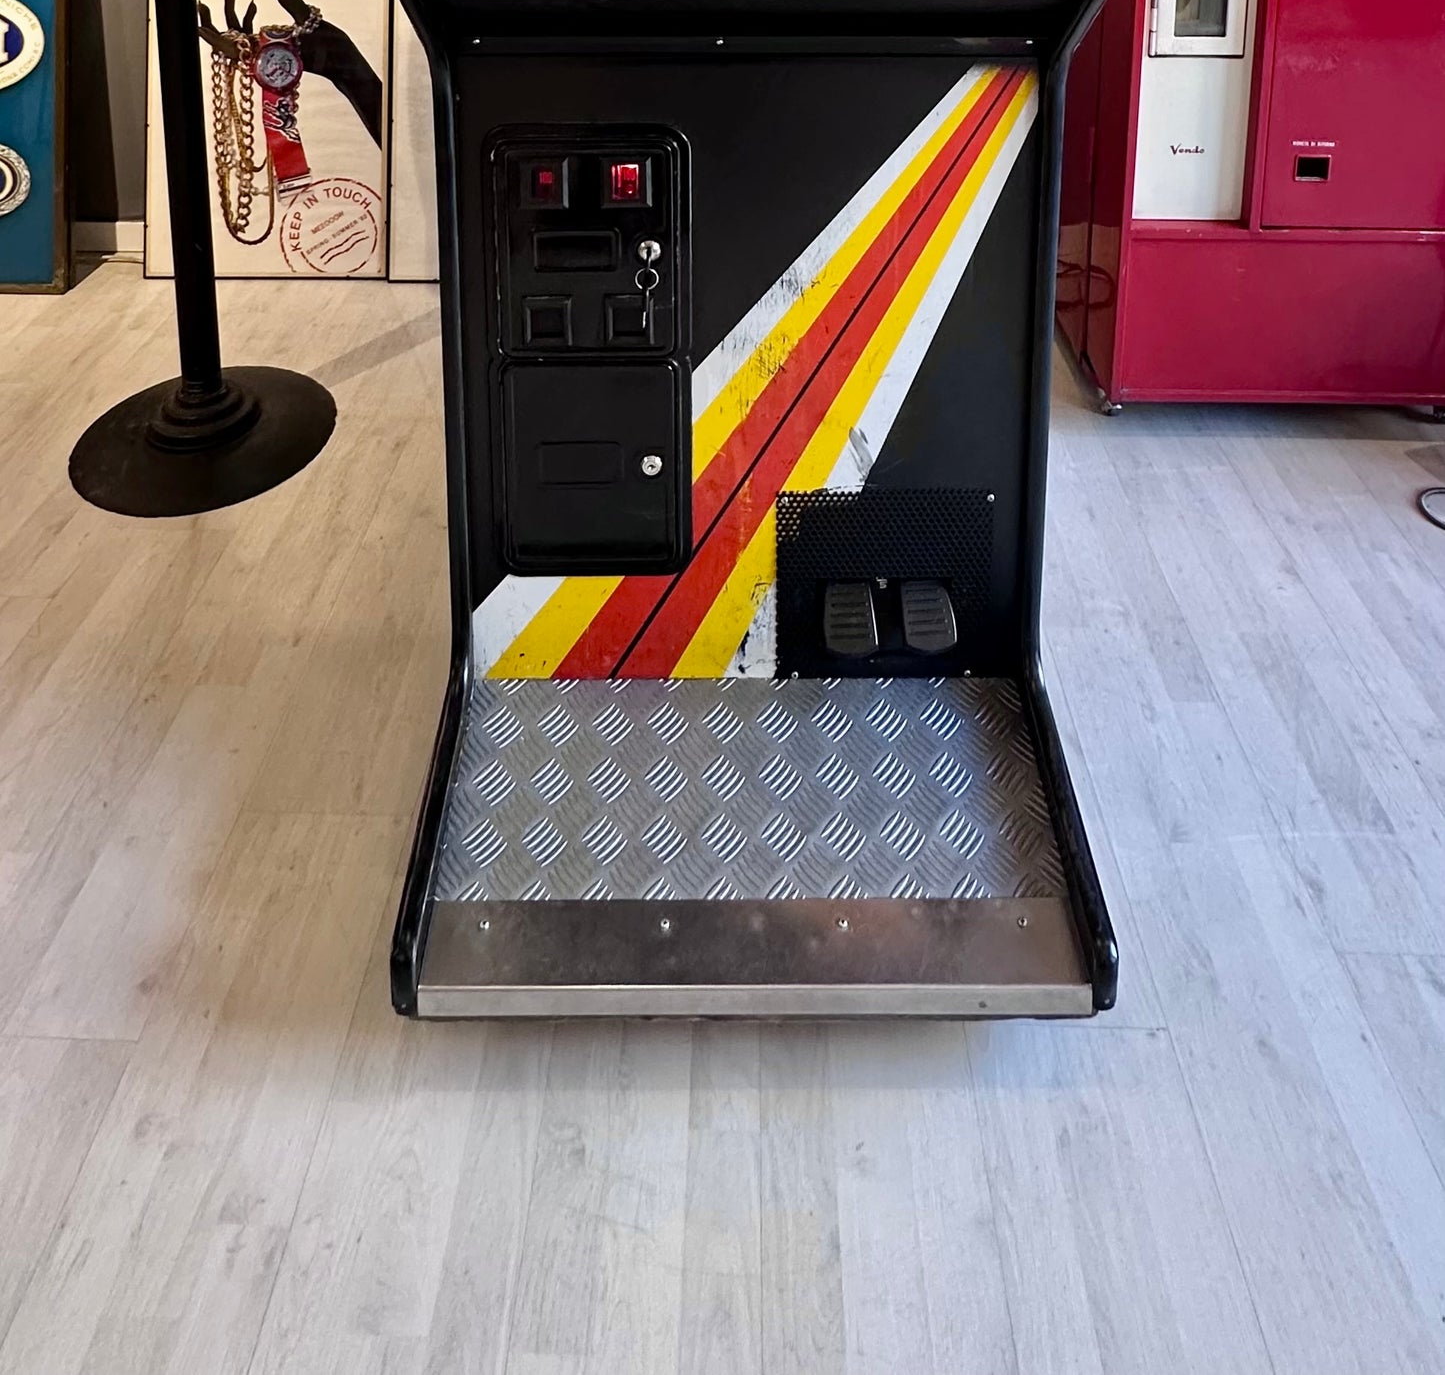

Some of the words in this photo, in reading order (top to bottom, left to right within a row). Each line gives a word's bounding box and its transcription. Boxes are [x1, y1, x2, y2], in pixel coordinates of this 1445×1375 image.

[1169, 142, 1206, 157] Vendo
[289, 211, 303, 252] KEEP
[303, 194, 319, 210] IN
[323, 186, 372, 210] TOUCH
